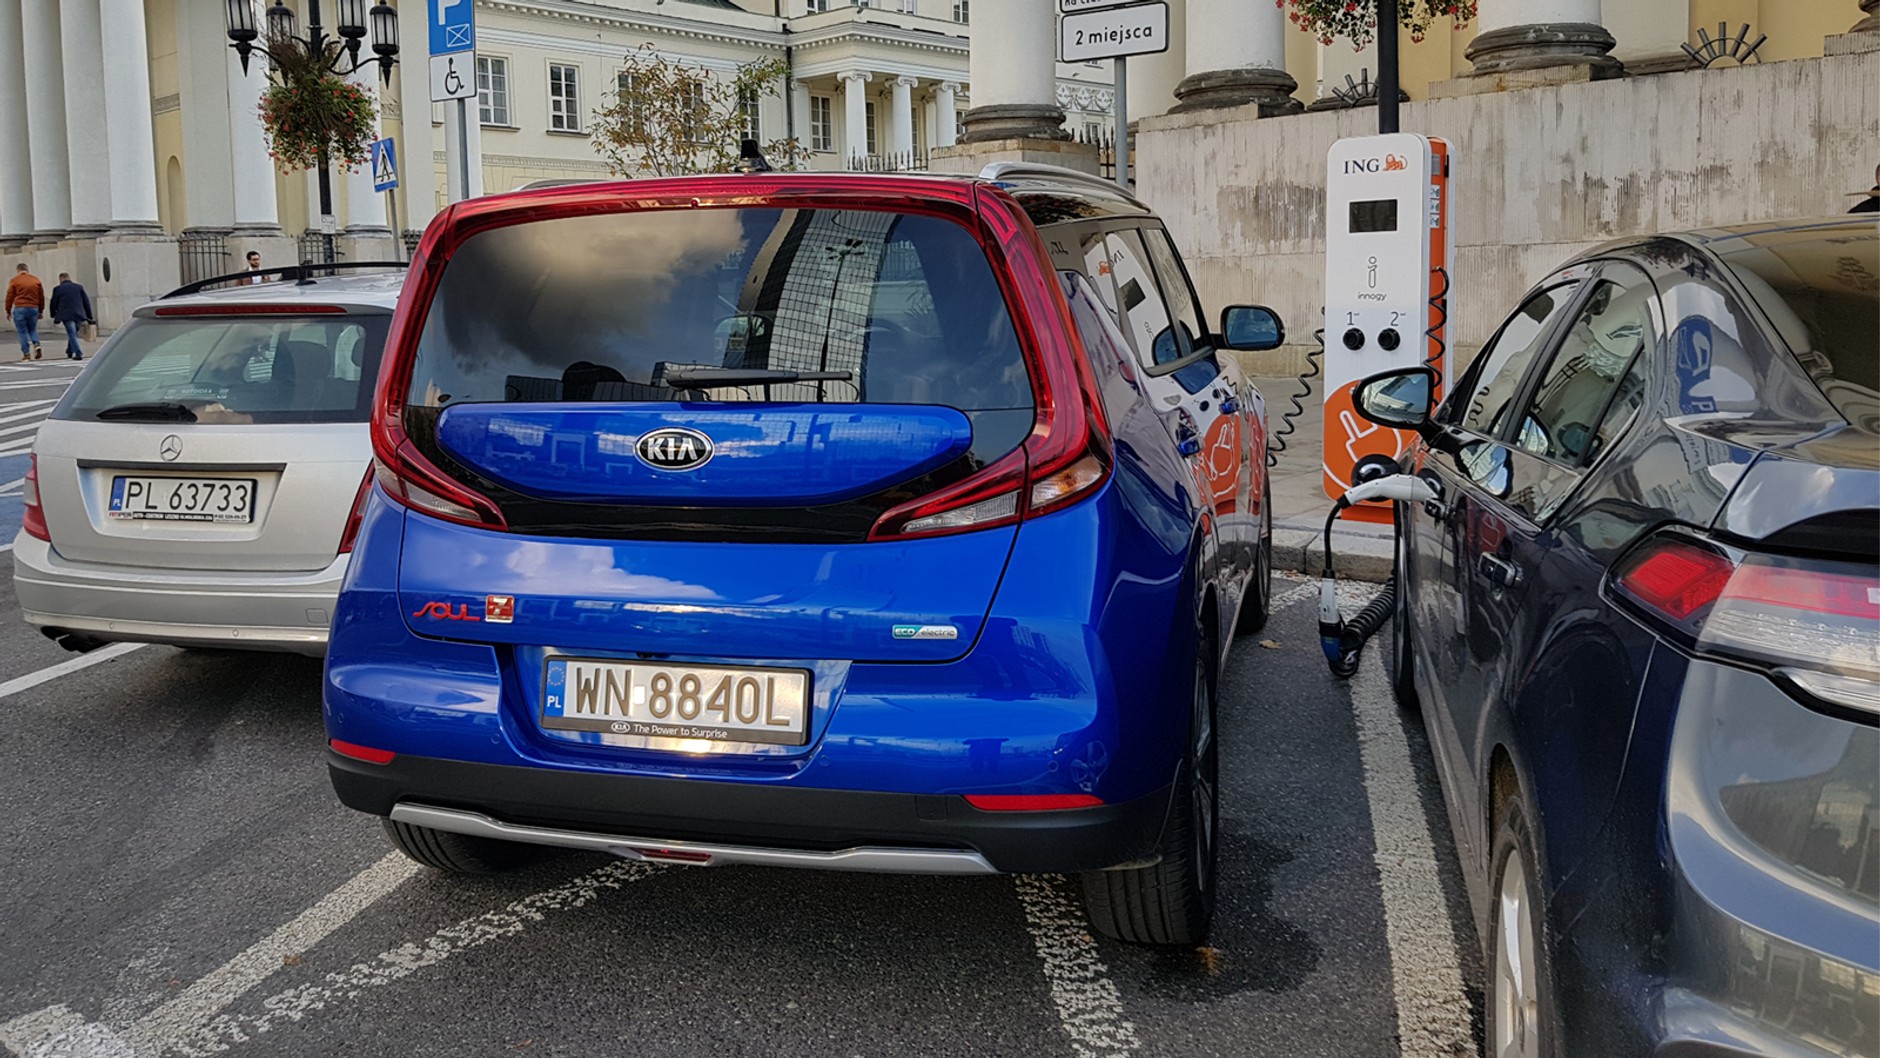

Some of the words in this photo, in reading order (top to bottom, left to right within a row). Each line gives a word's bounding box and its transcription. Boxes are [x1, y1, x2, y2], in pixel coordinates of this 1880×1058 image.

[1076, 30, 1083, 45] 2
[1089, 25, 1152, 44] miejsca
[1344, 158, 1380, 174] ING
[1358, 292, 1386, 301] innogy
[1346, 312, 1354, 326] 1
[1390, 312, 1399, 326] 2
[648, 438, 698, 460] KIA
[112, 498, 122, 506] PL
[126, 482, 157, 510] PL
[169, 482, 248, 512] 63733
[413, 602, 480, 621] SOUL
[895, 628, 916, 636] ECO
[922, 628, 956, 637] electric
[547, 696, 562, 708] PL
[576, 668, 632, 716] WN
[649, 672, 790, 726] 8840L
[634, 724, 648, 734] The
[651, 725, 678, 735] Power
[680, 726, 689, 736] to
[692, 728, 728, 738] Surprise
